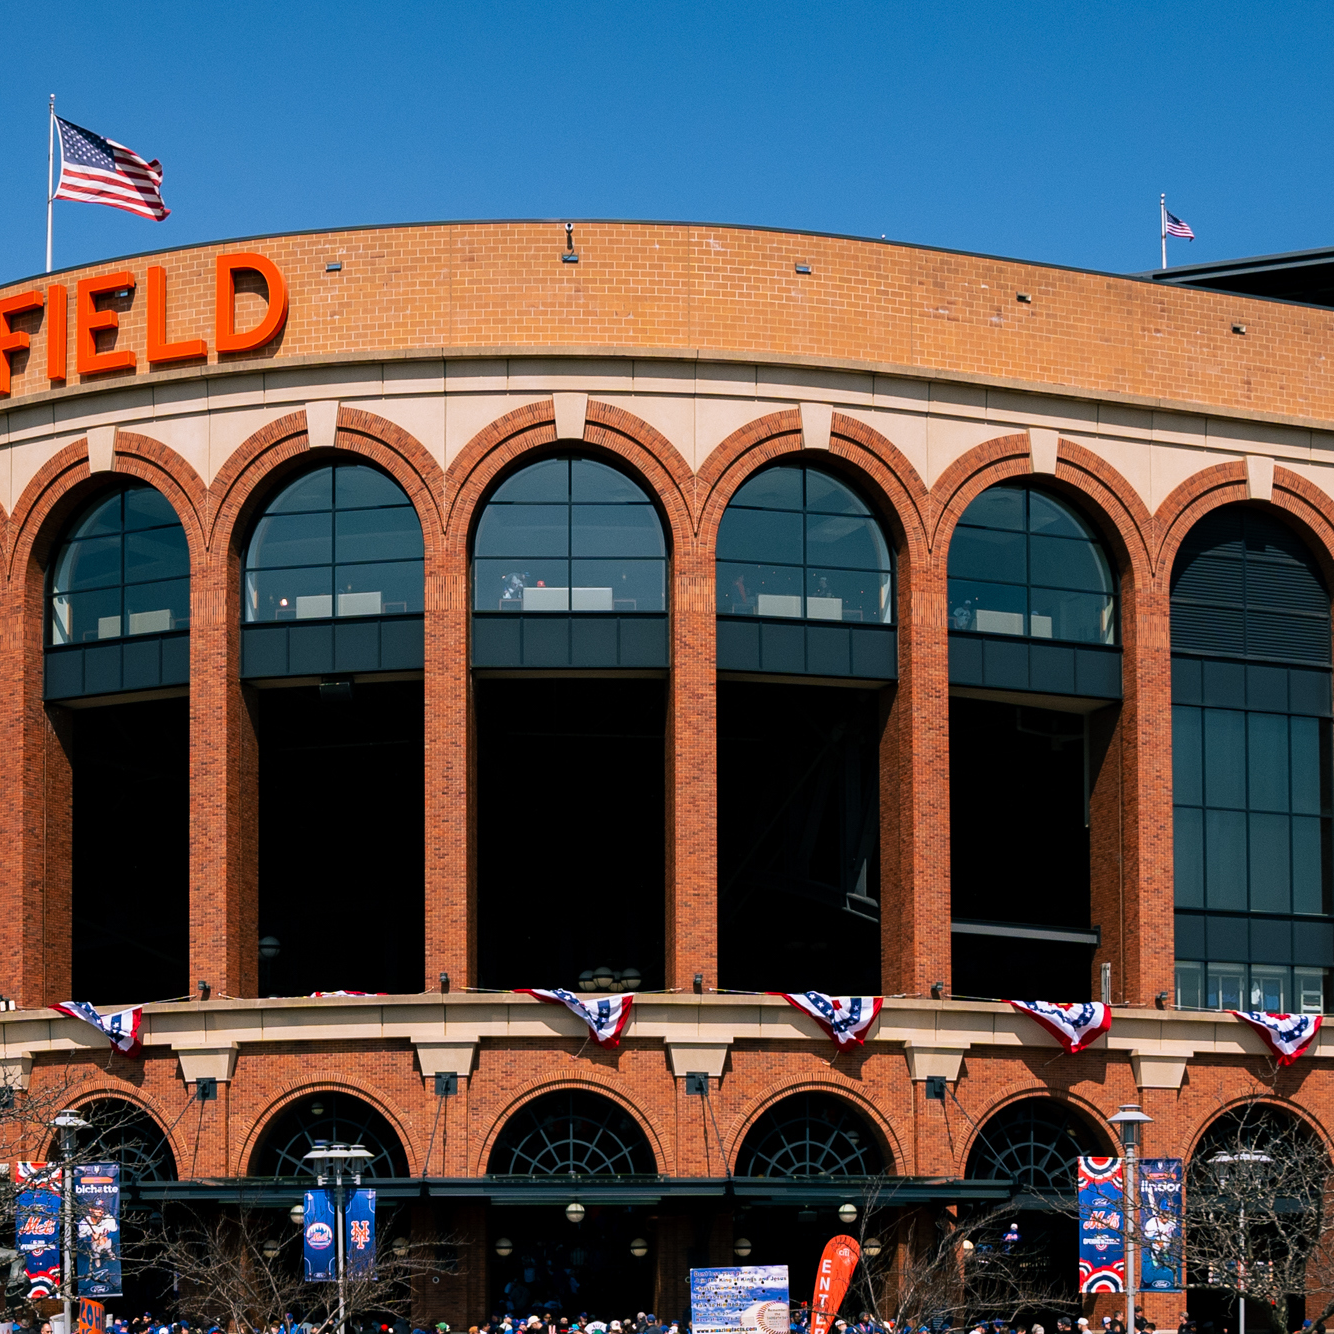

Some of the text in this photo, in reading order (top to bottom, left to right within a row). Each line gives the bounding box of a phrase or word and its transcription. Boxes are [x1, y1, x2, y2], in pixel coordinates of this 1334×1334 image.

[1140, 1180, 1181, 1192] lindor
[18, 1215, 56, 1235] Mets
[1082, 1210, 1120, 1230] Mets
[838, 1247, 850, 1257] citi
[696, 1326, 758, 1334] www.amazingfacts.com
